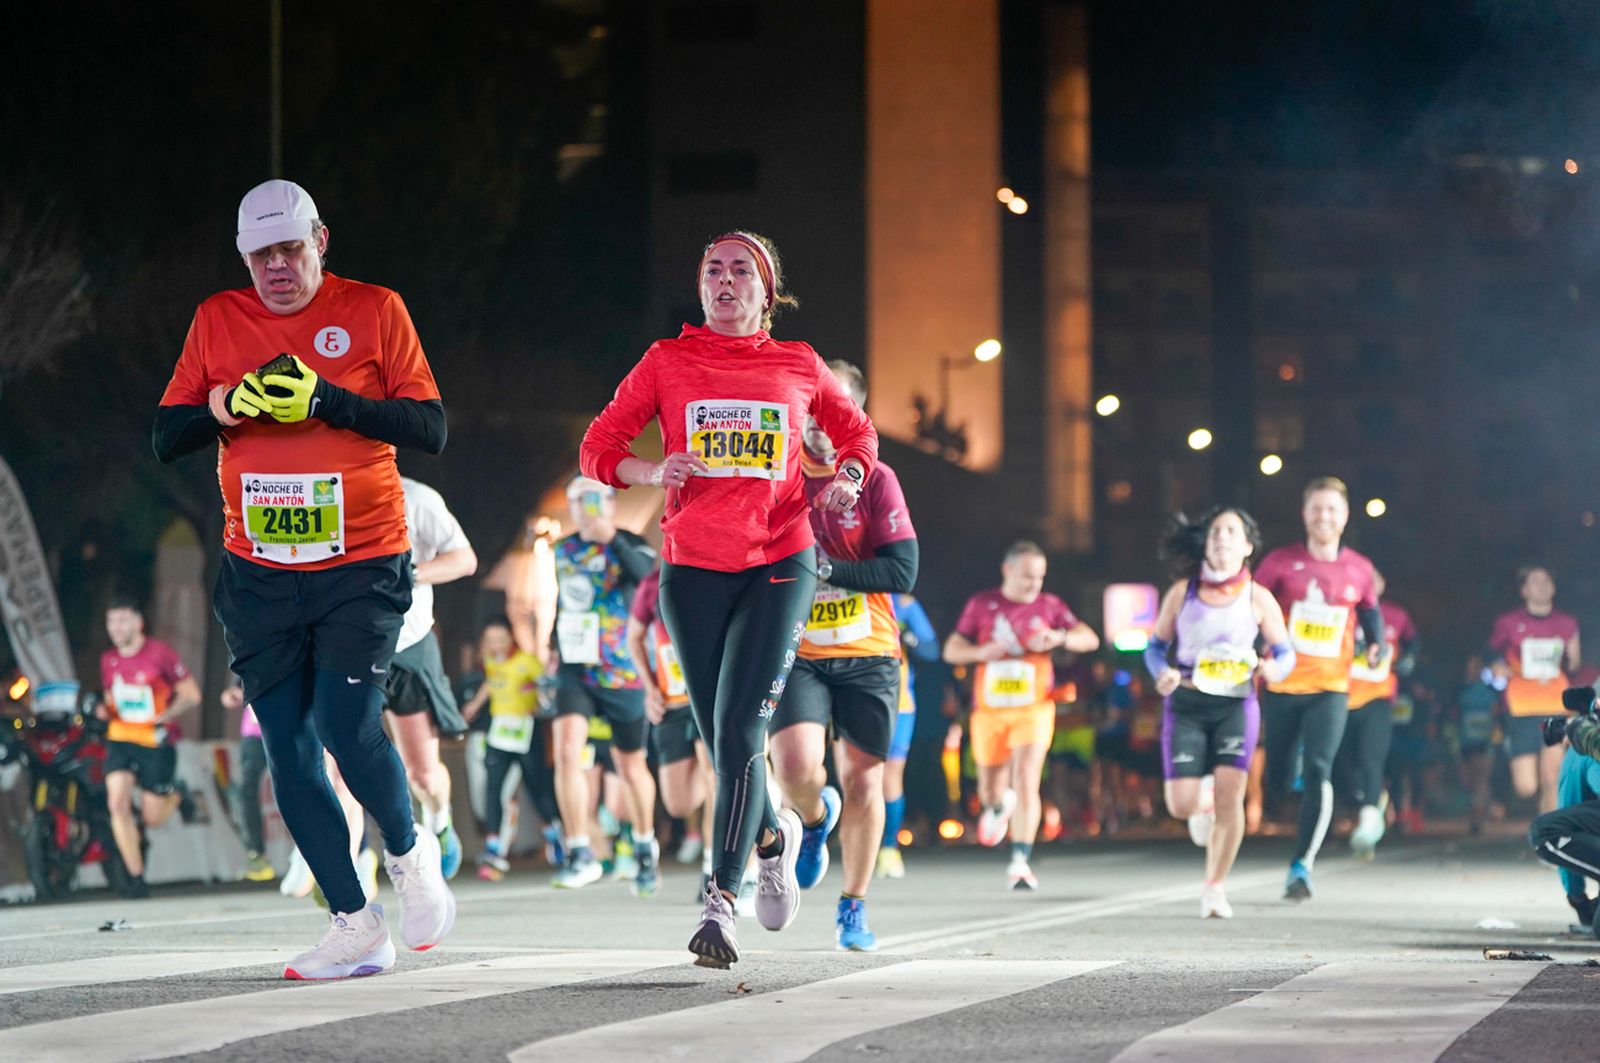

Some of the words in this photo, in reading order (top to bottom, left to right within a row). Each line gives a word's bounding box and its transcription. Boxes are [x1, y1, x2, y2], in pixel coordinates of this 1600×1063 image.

[709, 410, 739, 419] NOCHE
[740, 410, 752, 419] DE
[698, 421, 718, 431] SAN
[700, 431, 774, 459] 13044
[262, 485, 291, 494] NOCHE
[292, 485, 304, 494] DE
[252, 495, 270, 506] SAN
[272, 494, 305, 506] ANTÓN
[263, 507, 322, 535] 2431
